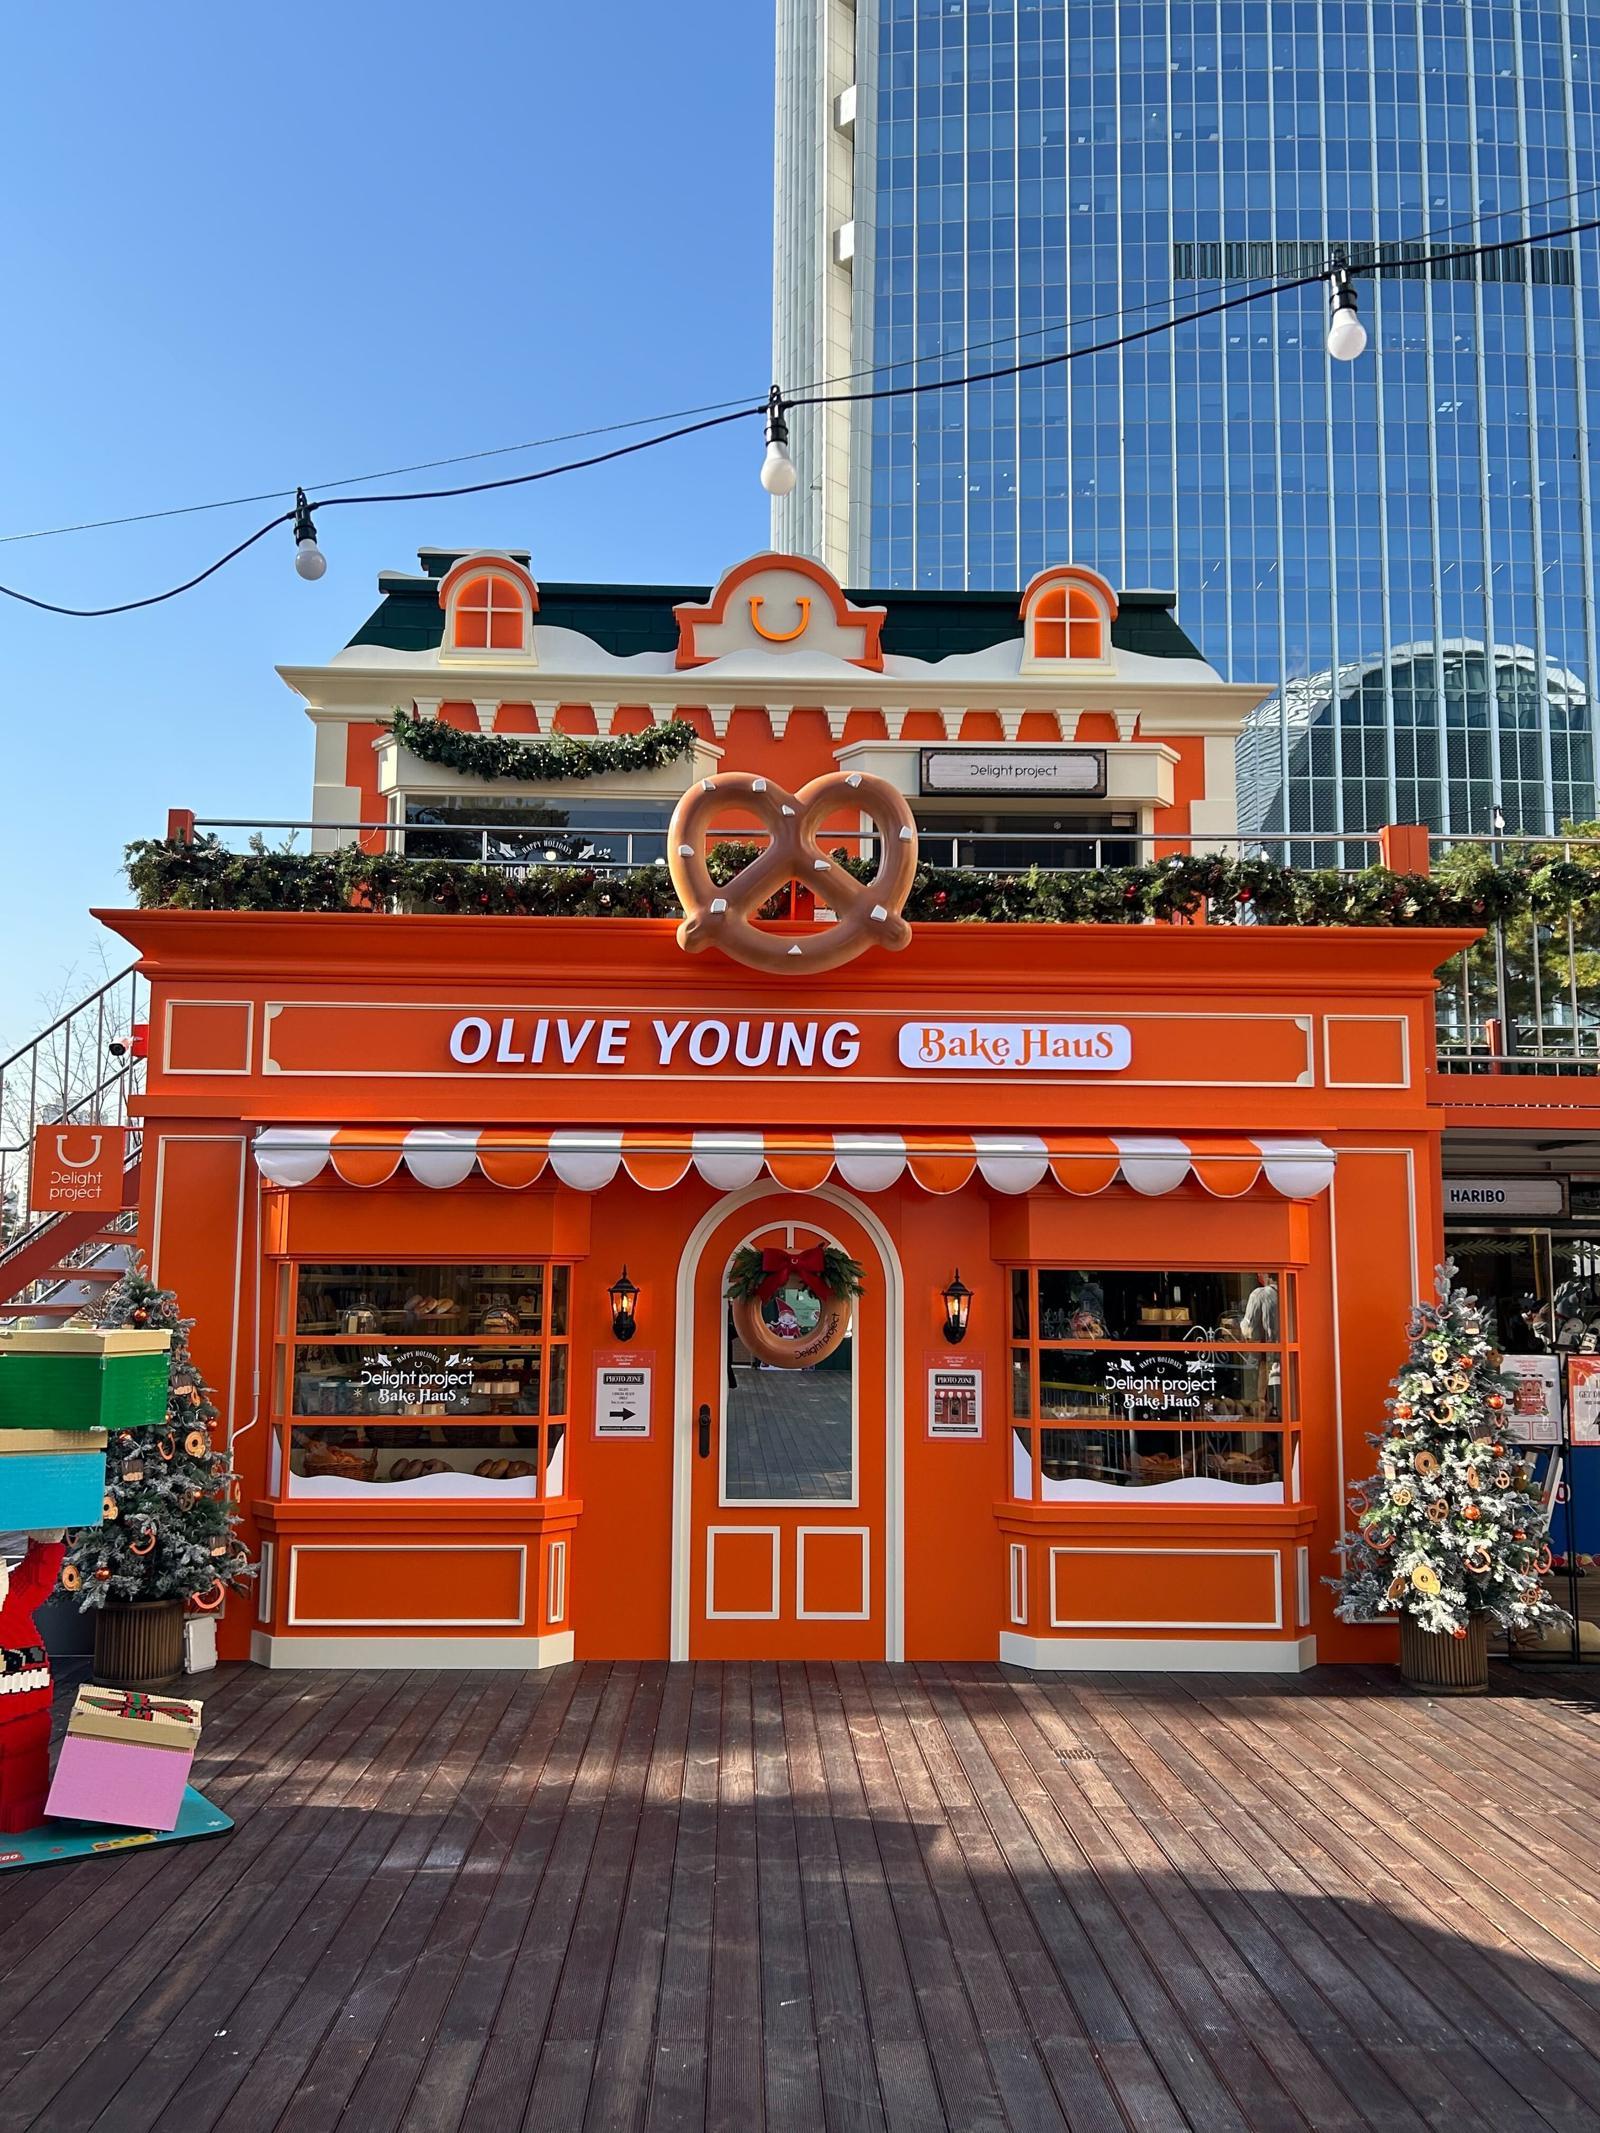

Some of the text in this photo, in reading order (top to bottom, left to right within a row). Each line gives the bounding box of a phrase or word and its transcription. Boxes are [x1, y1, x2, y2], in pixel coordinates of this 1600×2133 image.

[970, 764, 1058, 779] Delight project
[521, 839, 574, 856] HAPPY HOLIDAYS
[449, 1016, 861, 1069] OLIVE YOUNG
[918, 1027, 1011, 1066] Bake
[50, 1171, 103, 1188] Delight
[49, 1185, 103, 1202] project
[1450, 1189, 1506, 1203] HARIBO
[794, 1311, 840, 1360] Delight project
[396, 1350, 441, 1364] HAPPY HOLIDAYS
[1139, 1356, 1184, 1370] HAPPY HOLIDAYS
[361, 1370, 475, 1389] Delight project
[605, 1375, 642, 1384] PHOTO ZONE
[937, 1376, 972, 1384] PHOTO ZONE
[1105, 1375, 1218, 1395] Delight project
[378, 1388, 416, 1405] Bake
[1123, 1393, 1160, 1410] Bake
